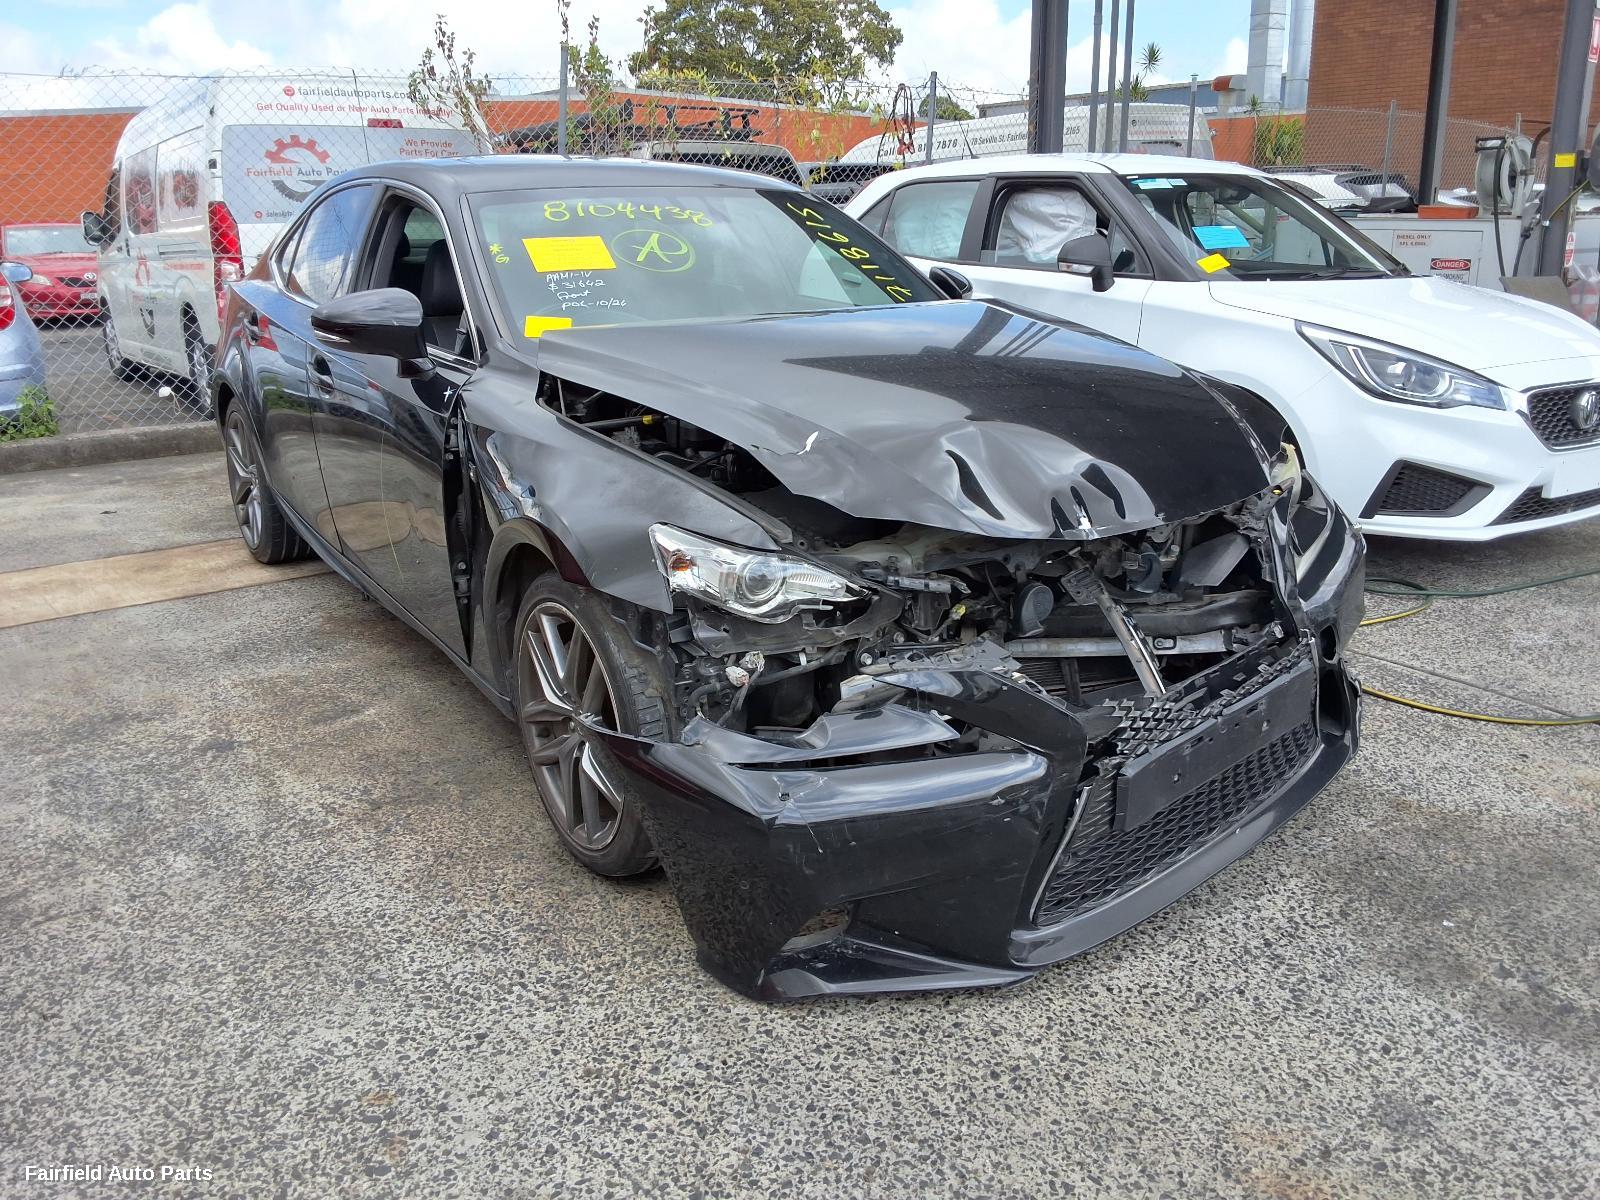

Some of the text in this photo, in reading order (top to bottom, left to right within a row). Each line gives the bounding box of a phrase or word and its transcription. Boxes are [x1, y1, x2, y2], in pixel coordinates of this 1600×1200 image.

[298, 86, 429, 101] fairfieldautoparts.coau
[256, 102, 273, 111] Get
[276, 102, 309, 113] Quality
[311, 104, 334, 112] Used
[349, 105, 368, 113] New
[371, 105, 390, 114] Auto
[392, 106, 414, 115] Parts
[404, 138, 453, 149] We Provide
[978, 135, 998, 145] Seville
[400, 148, 423, 156] Parts
[424, 149, 438, 157] For
[879, 145, 896, 157] Call
[936, 139, 958, 150] 7878
[245, 167, 348, 177] Fairfield Auto Par
[543, 200, 713, 227] 8104438
